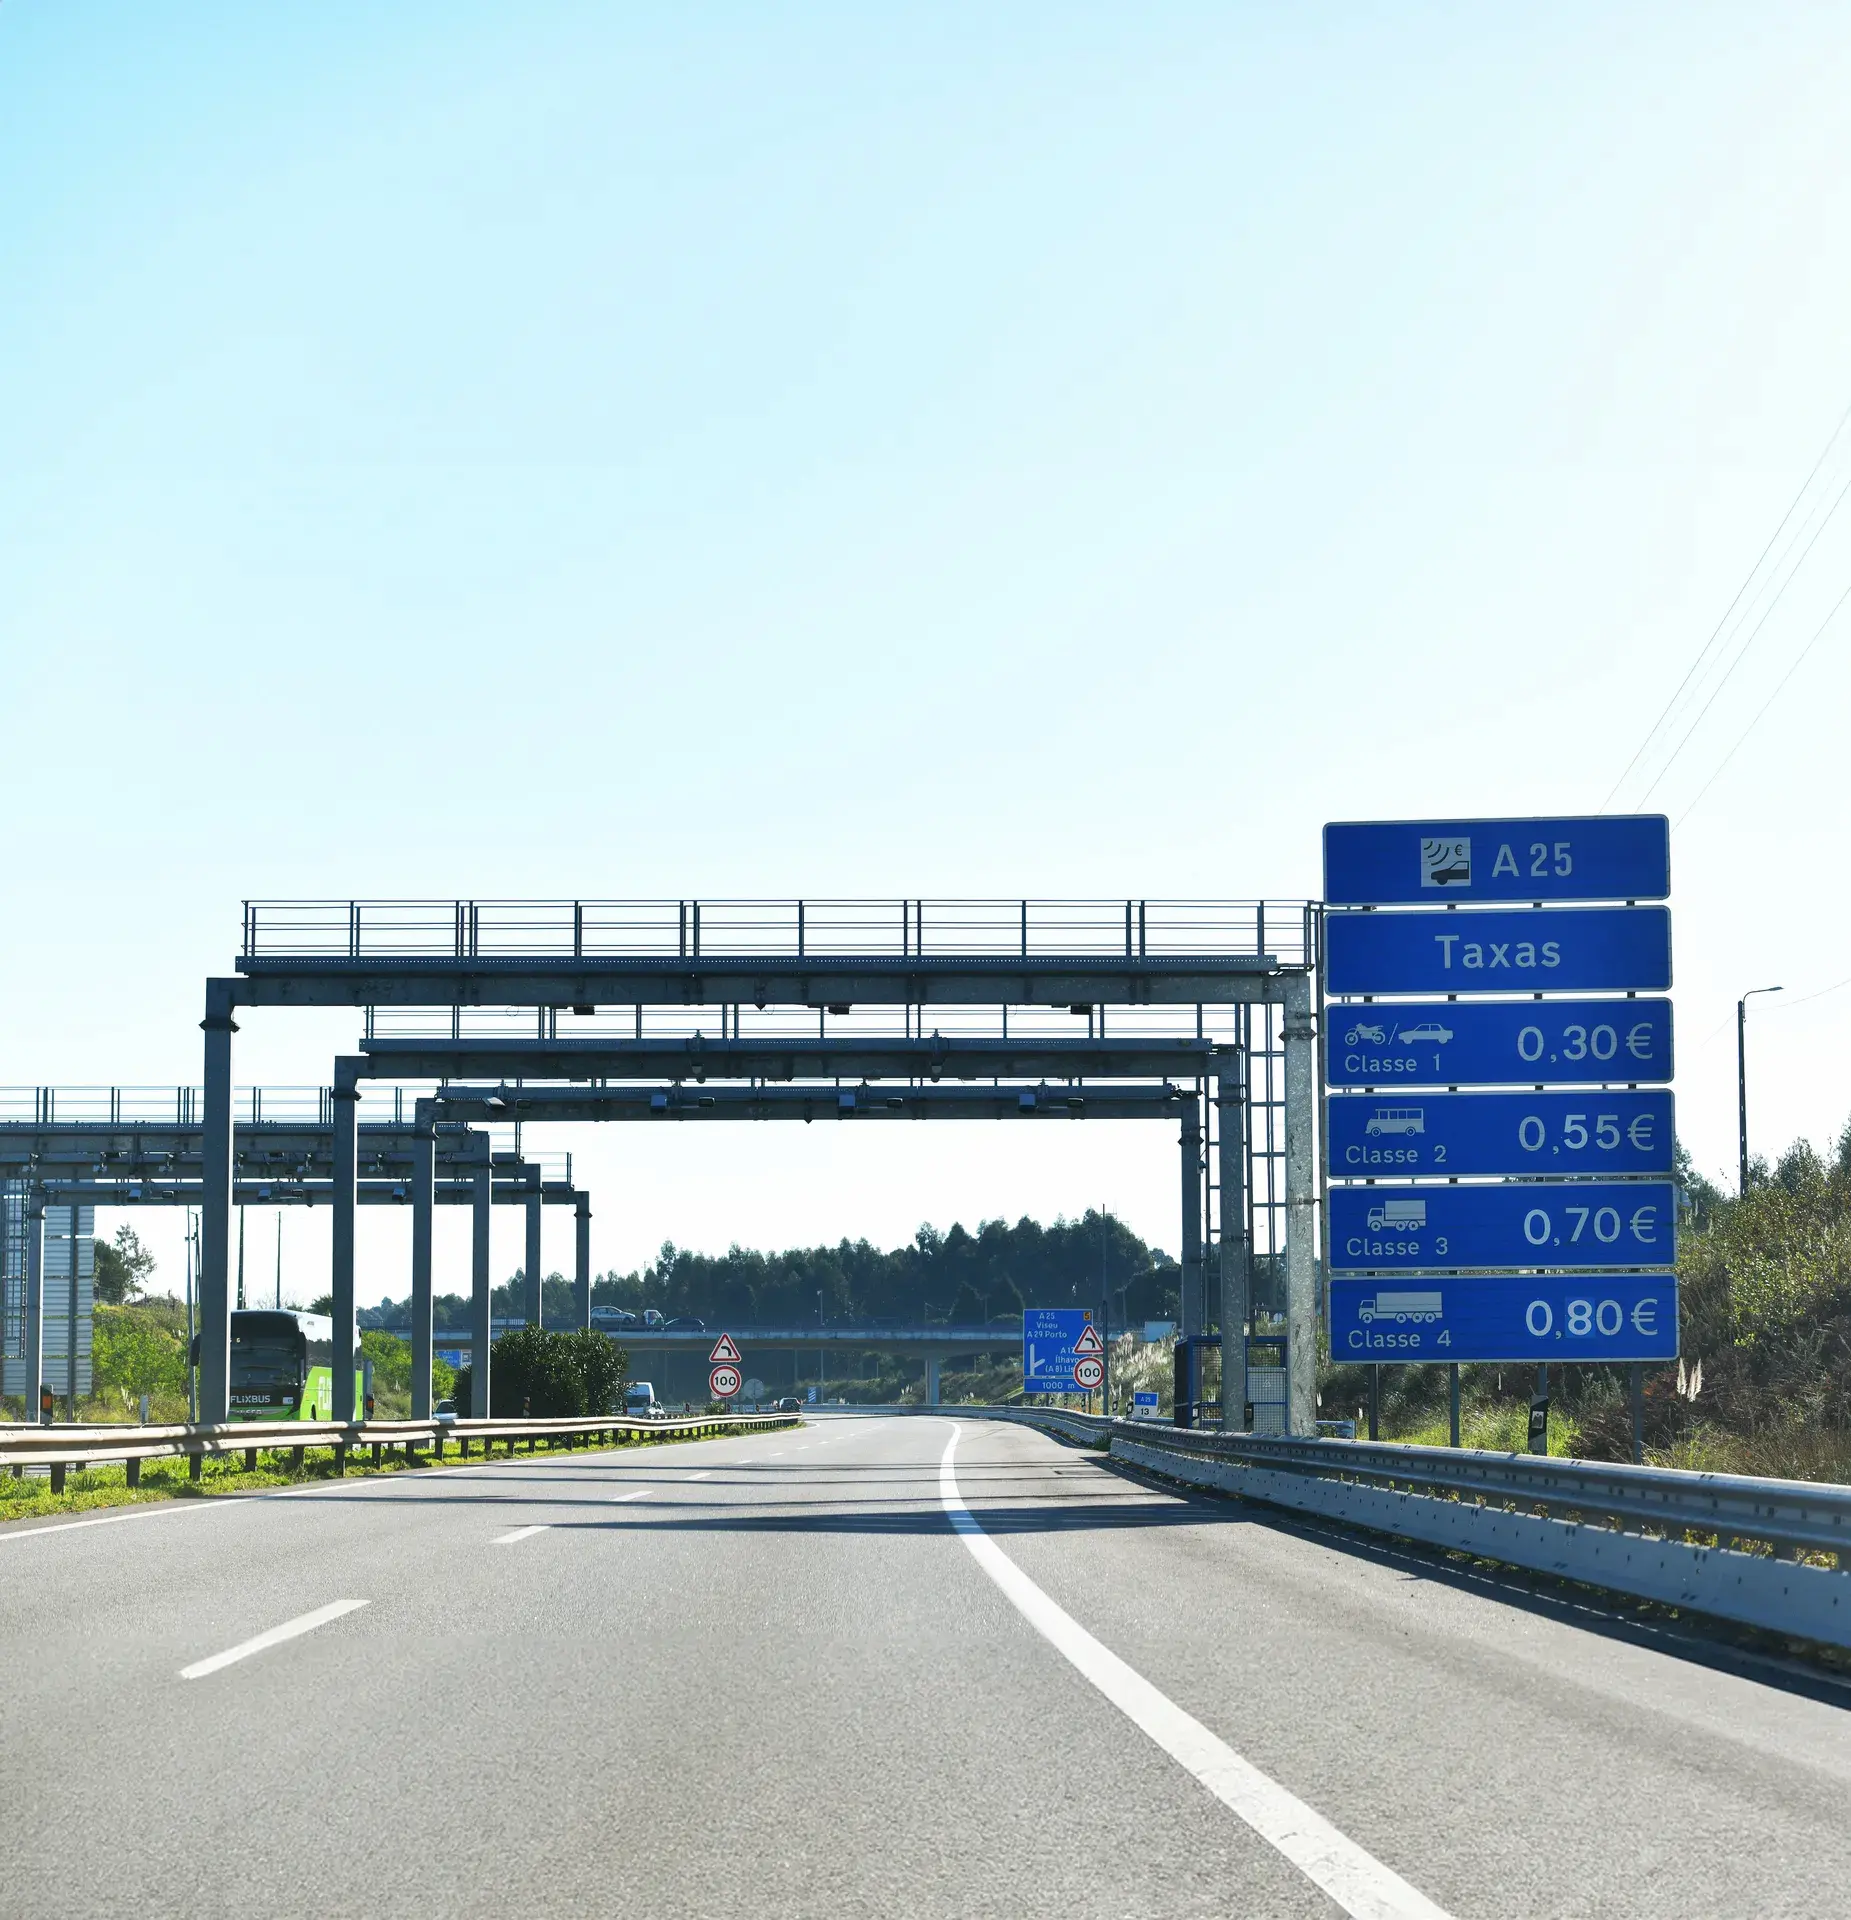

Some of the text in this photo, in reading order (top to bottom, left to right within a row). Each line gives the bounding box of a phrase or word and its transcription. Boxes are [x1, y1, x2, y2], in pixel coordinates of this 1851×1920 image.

[1491, 842, 1573, 878] A 25
[1435, 935, 1561, 969] Taxas
[1345, 1053, 1441, 1073] Classe 1
[1345, 1145, 1447, 1165] Classe 2
[1346, 1237, 1449, 1257] Classe 3
[1046, 1312, 1055, 1320] 25
[1045, 1331, 1068, 1339] Porto
[1348, 1330, 1452, 1349] Classe 4
[714, 1376, 737, 1386] 100
[1078, 1368, 1101, 1378] 100
[1140, 1407, 1150, 1415] 13
